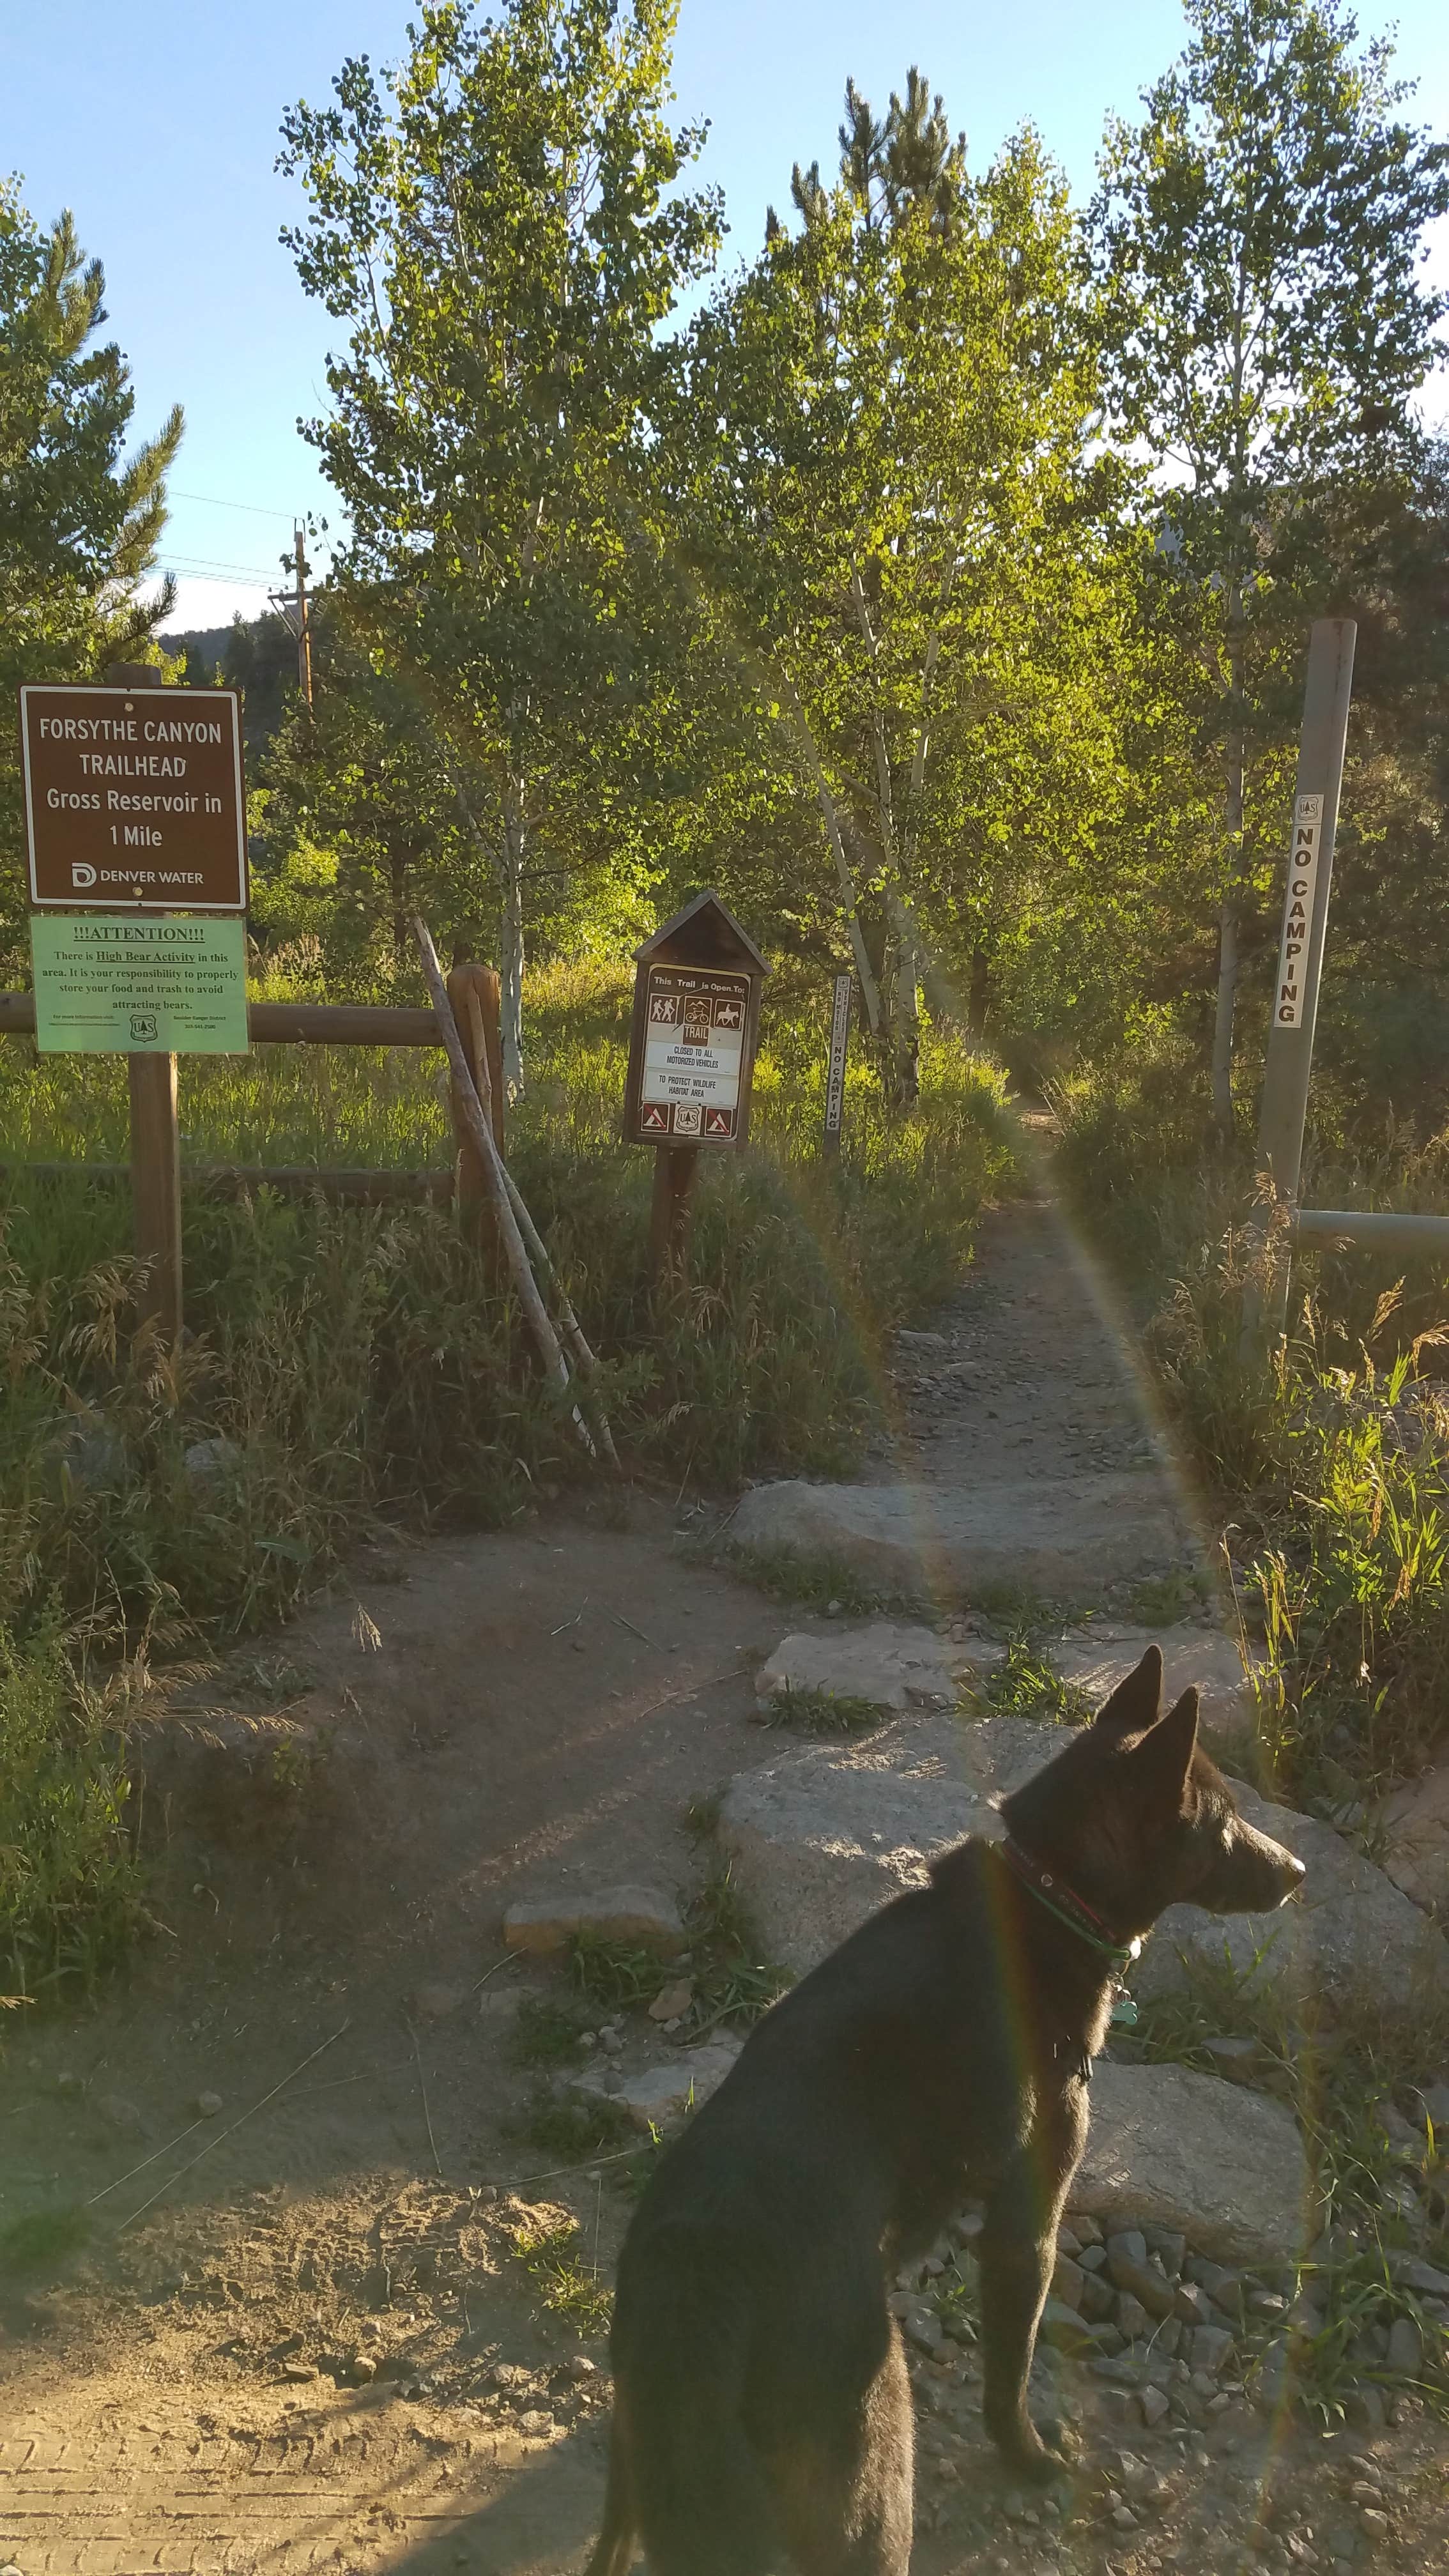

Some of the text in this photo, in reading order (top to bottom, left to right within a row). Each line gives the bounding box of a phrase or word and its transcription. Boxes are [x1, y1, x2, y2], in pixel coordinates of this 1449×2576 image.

[40, 718, 222, 744] FORSYTHE CANYON
[79, 754, 187, 777] TRAILHEAD
[47, 788, 222, 813] Gross Reservoir in
[110, 825, 163, 847] 1 Mile
[1294, 829, 1314, 867] NO
[100, 870, 204, 884] DENVER WATER
[74, 927, 204, 940] !!!ATTENTION!!!
[53, 951, 229, 962] There is High Bear Activity in this
[1278, 880, 1308, 1022] CAMPING
[69, 968, 77, 977] It
[80, 968, 88, 977] is
[91, 970, 113, 979] your
[116, 969, 181, 980] responsibility
[197, 970, 239, 981] properly
[86, 986, 109, 994] your
[111, 984, 133, 992] food
[136, 985, 153, 993] and
[197, 985, 223, 993] avoid
[654, 976, 671, 985] This
[677, 979, 695, 988] Trail
[710, 983, 732, 992] Open
[112, 1000, 192, 1011] attracting bears.
[685, 1026, 708, 1039] TRAIL
[674, 1046, 693, 1055] CLOSED
[666, 1055, 719, 1068] MOTORIZED VEHICLES
[668, 1077, 691, 1085] PROTECT
[693, 1079, 716, 1089] WILDLIFE
[829, 1046, 841, 1128] NO CAMPING
[669, 1087, 704, 1098] HABITAT AREA
